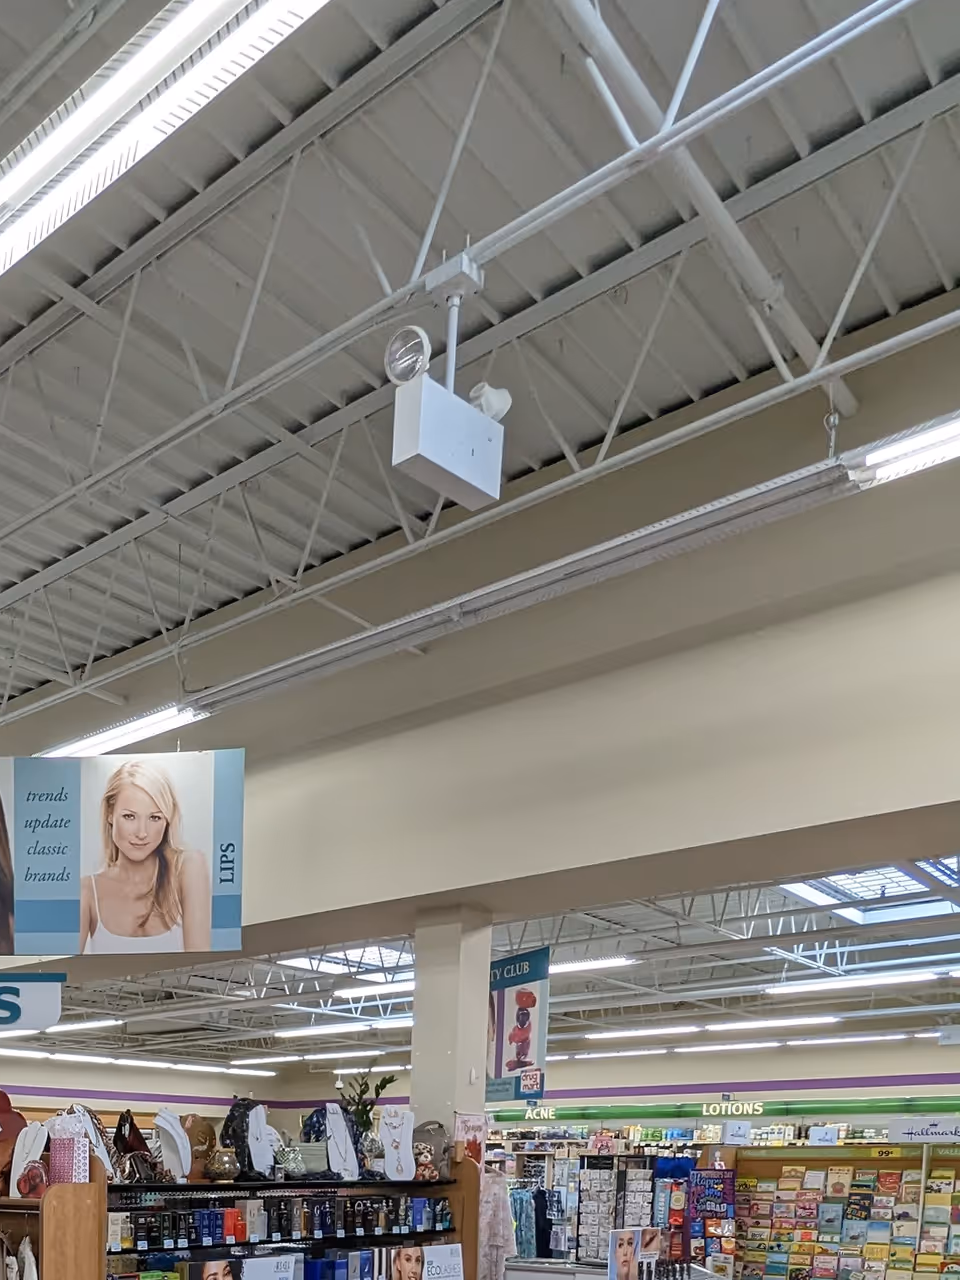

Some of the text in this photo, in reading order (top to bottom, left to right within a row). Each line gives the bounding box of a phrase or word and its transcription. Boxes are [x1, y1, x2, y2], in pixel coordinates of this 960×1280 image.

[26, 787, 68, 802] trends
[24, 815, 70, 831] update
[27, 841, 68, 856] classic
[219, 842, 236, 884] LIPS
[24, 868, 70, 883] brands
[504, 961, 530, 979] CLUB
[522, 1072, 538, 1082] drug
[522, 1082, 540, 1090] mart
[525, 1108, 556, 1120] ACNE
[702, 1102, 763, 1117] LOTIONS
[902, 1124, 960, 1140] Hallmark
